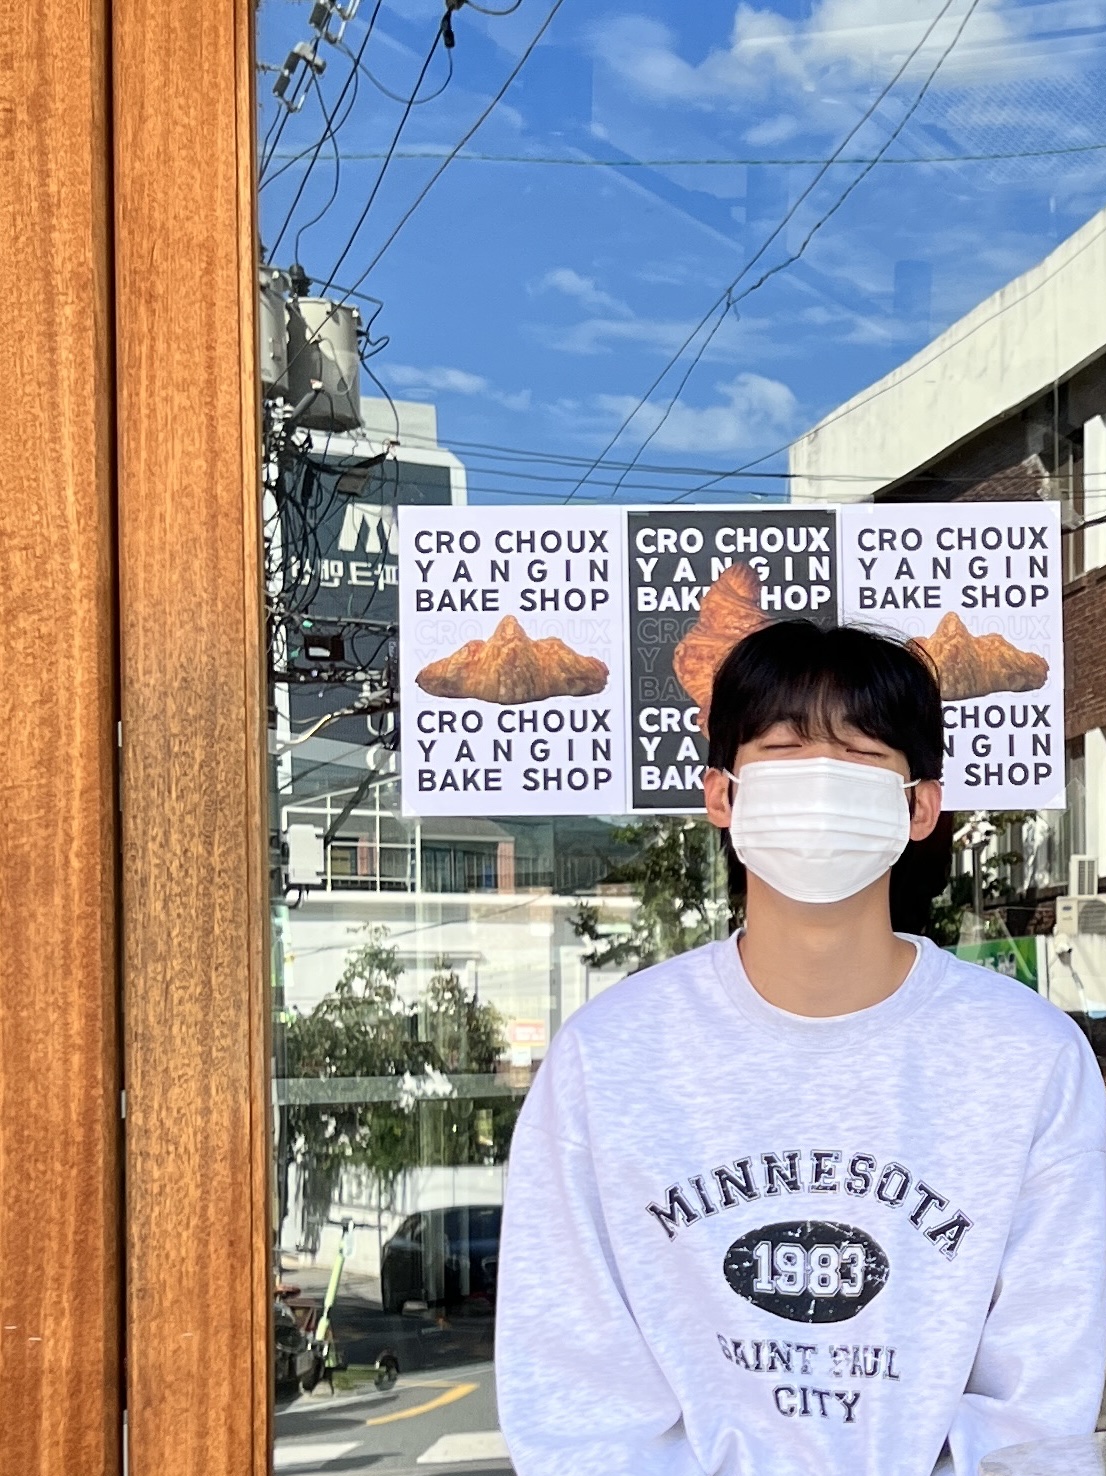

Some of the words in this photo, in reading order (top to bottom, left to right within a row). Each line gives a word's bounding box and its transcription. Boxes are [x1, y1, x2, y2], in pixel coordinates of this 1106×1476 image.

[414, 530, 483, 554] CRO
[495, 529, 609, 554] CHOUX
[635, 527, 704, 554] CRO
[714, 526, 831, 553] CHOUX
[857, 527, 924, 552] CRO
[936, 526, 1049, 552] CHOUX
[414, 558, 610, 583] YANGIN
[857, 555, 1050, 581] YANGIN
[416, 588, 501, 612] BAKE
[519, 587, 611, 612] SHOP
[636, 586, 711, 612] BAK
[759, 585, 832, 611] HOP
[859, 585, 943, 610] BAKE
[960, 584, 1050, 609] SHOP
[416, 709, 485, 734] CRO
[498, 708, 612, 734] CHOUX
[417, 738, 613, 764] YANGIN
[418, 768, 503, 792] BAKE
[522, 767, 614, 792] SHOP
[640, 765, 705, 791] BAK
[963, 762, 1053, 787] SHOP
[645, 1149, 975, 1262] MINNESOTA
[752, 1240, 867, 1298] 1983
[716, 1331, 819, 1375] SAINT
[772, 1383, 862, 1424] CITY
